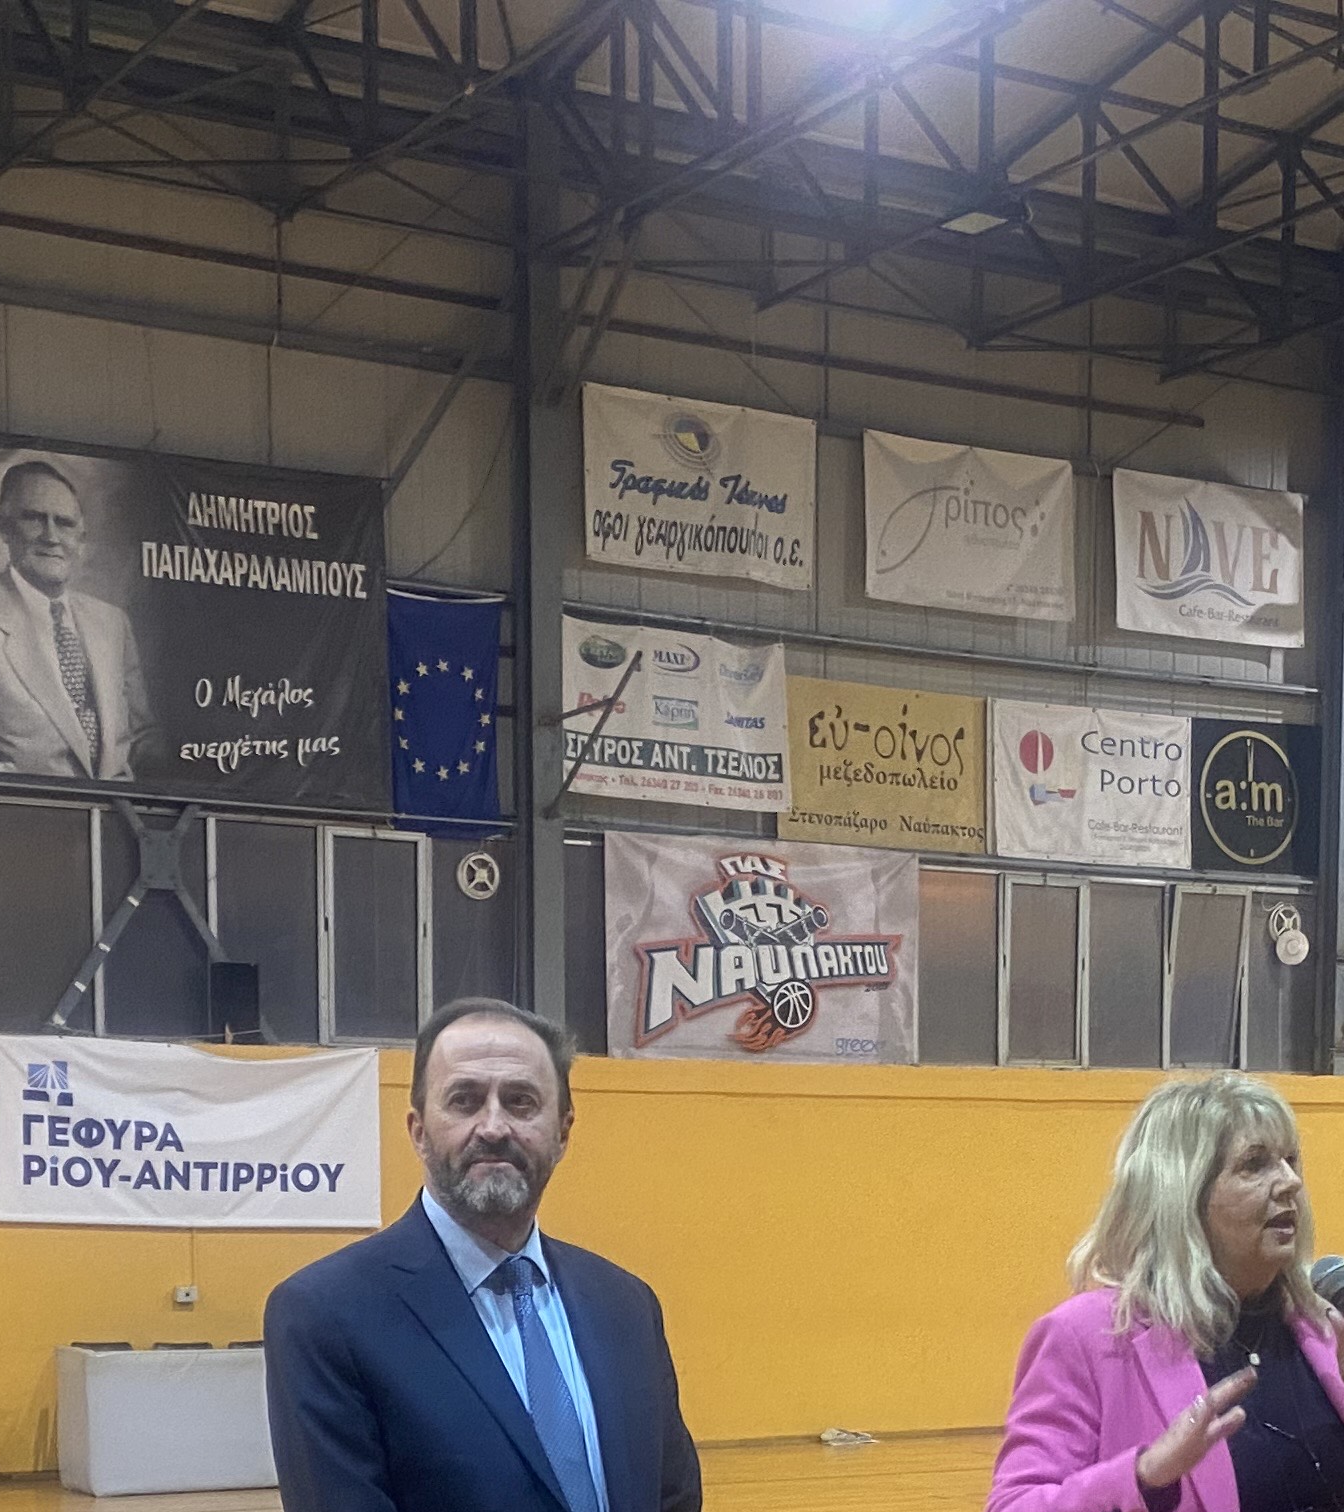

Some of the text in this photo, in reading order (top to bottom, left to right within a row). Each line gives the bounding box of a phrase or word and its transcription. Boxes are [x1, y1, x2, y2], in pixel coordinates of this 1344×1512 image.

[187, 492, 319, 540] ΔΗΜΗΤΡΙΟΣ
[141, 541, 368, 600] ΠΑΠΑΧΑΡΑΛΑΜΠΟΥΣ
[195, 675, 315, 718] Ο Μεγάλος
[179, 735, 341, 774] ευεργέτης μας
[650, 743, 697, 772] ΑΝΤ.
[703, 748, 782, 780] ΤΣΕΛΙΟΣ
[1080, 730, 1183, 762] Centro
[819, 759, 958, 791] μεζεδοπωλείο
[1100, 768, 1182, 798] Porto
[1214, 778, 1283, 814] a:m
[788, 806, 985, 843] Στενοπάζαρο Ναύπακτος
[1245, 815, 1284, 828] The Bar
[719, 855, 789, 883] ΠΑΣ
[22, 1113, 185, 1153] ΓΕΦΥΡΑ
